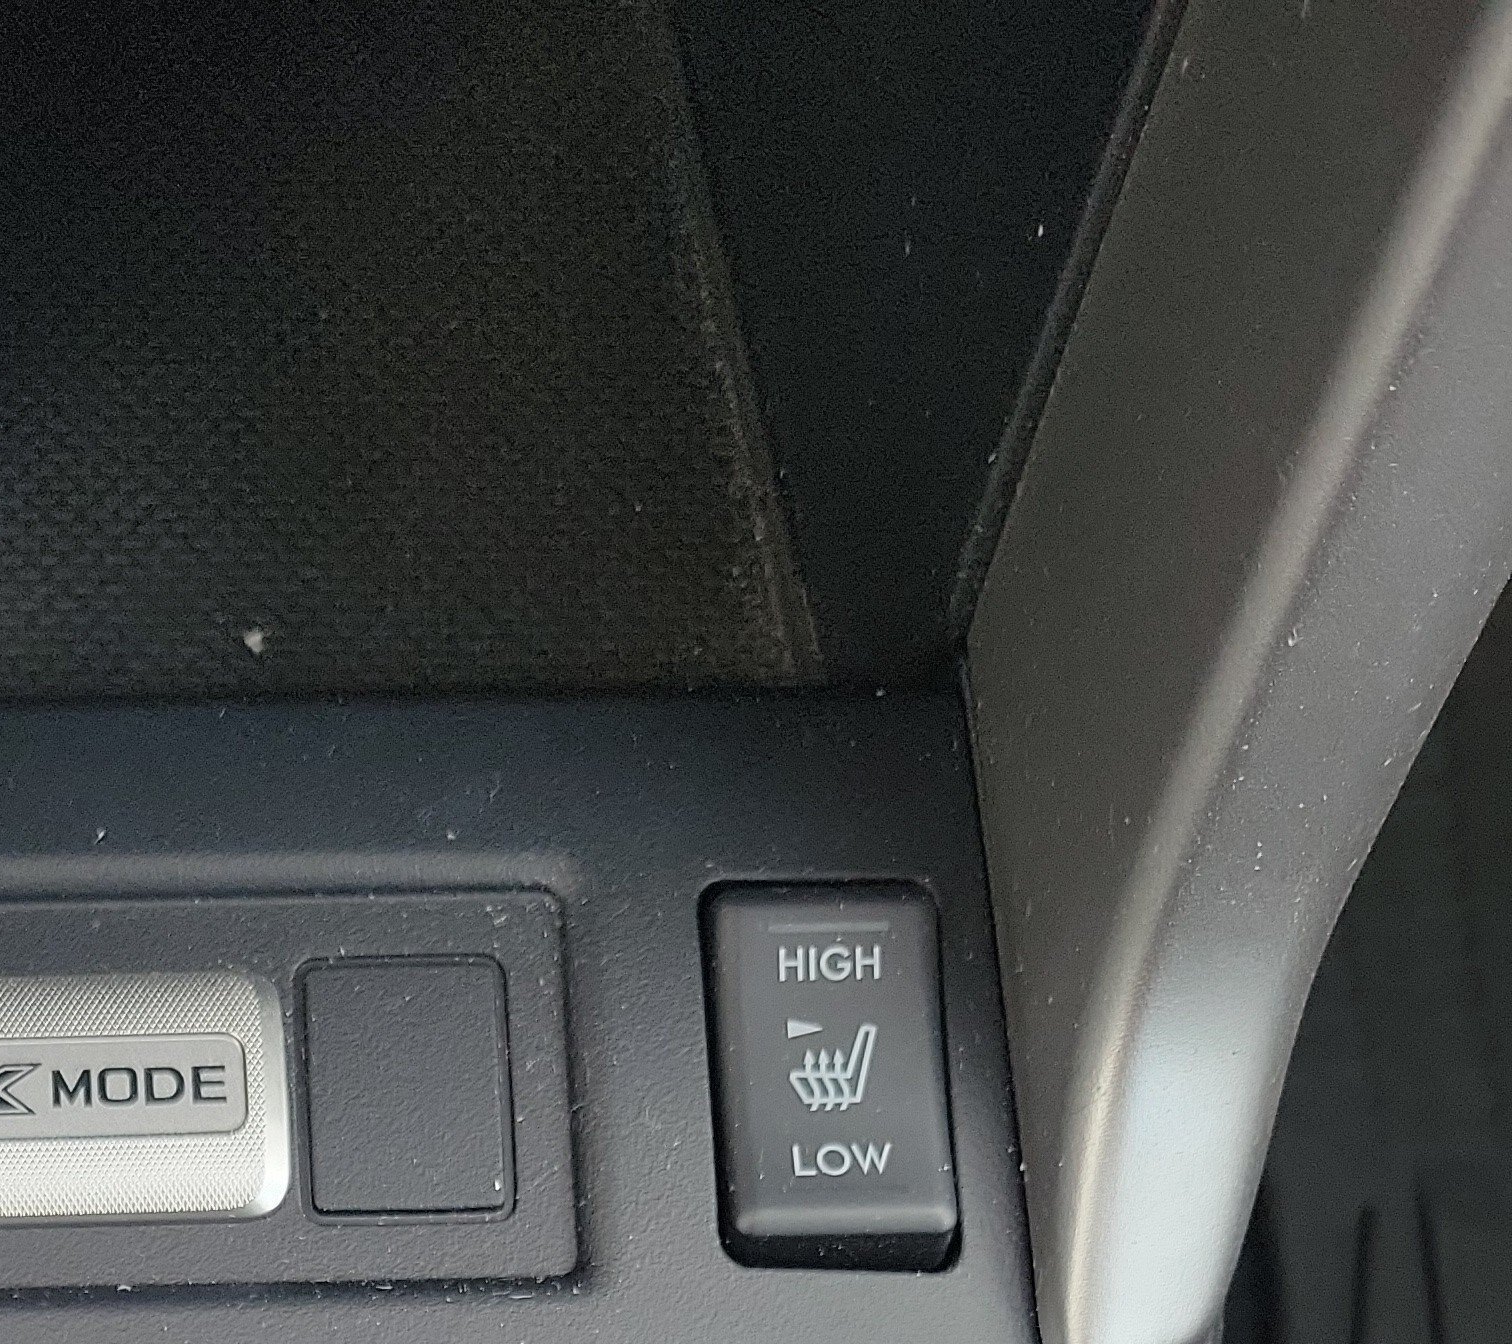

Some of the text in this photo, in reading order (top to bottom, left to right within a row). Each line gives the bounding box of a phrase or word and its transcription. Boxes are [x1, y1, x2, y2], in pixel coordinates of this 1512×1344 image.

[777, 944, 882, 983] HIGH
[51, 1064, 228, 1109] MODE
[791, 1142, 892, 1178] LOW
